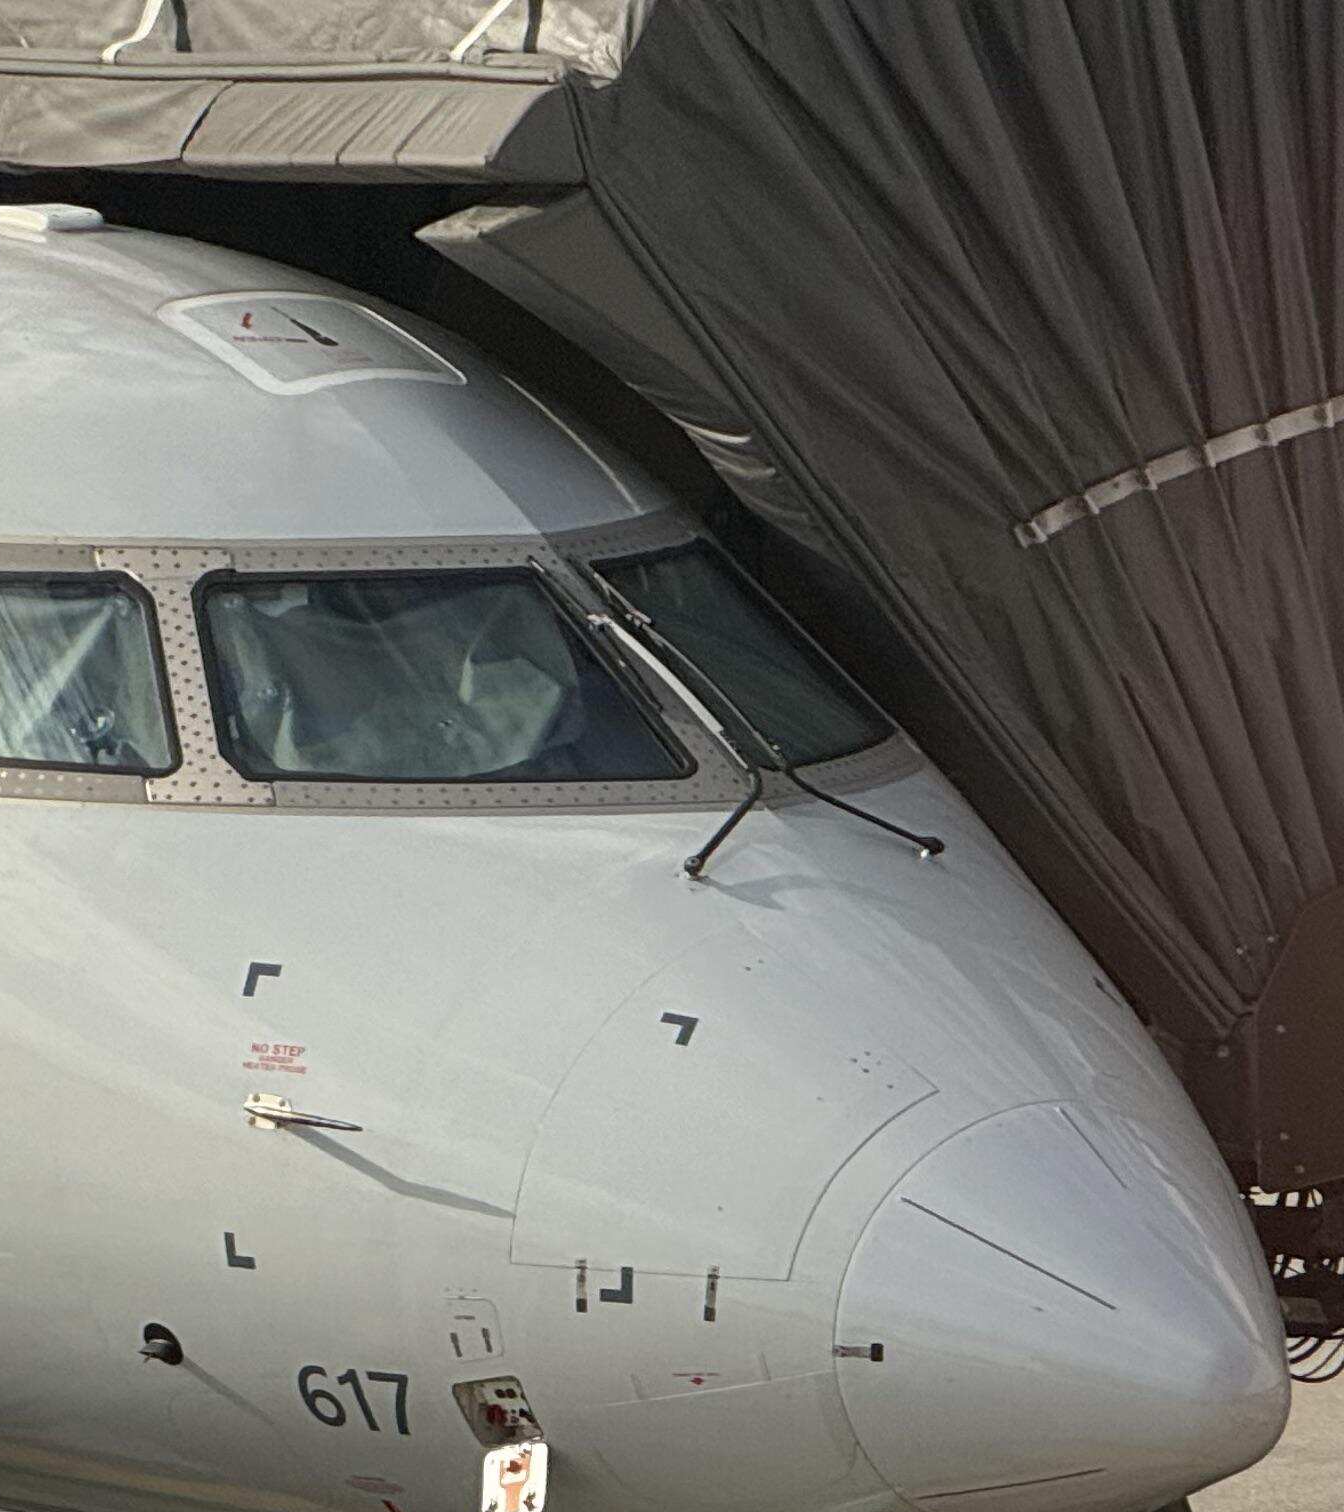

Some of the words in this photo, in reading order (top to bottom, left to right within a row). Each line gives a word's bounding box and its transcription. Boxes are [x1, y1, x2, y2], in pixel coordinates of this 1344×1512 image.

[251, 1042, 269, 1053] NO
[272, 1044, 306, 1056] STEP
[298, 1365, 411, 1436] 617
